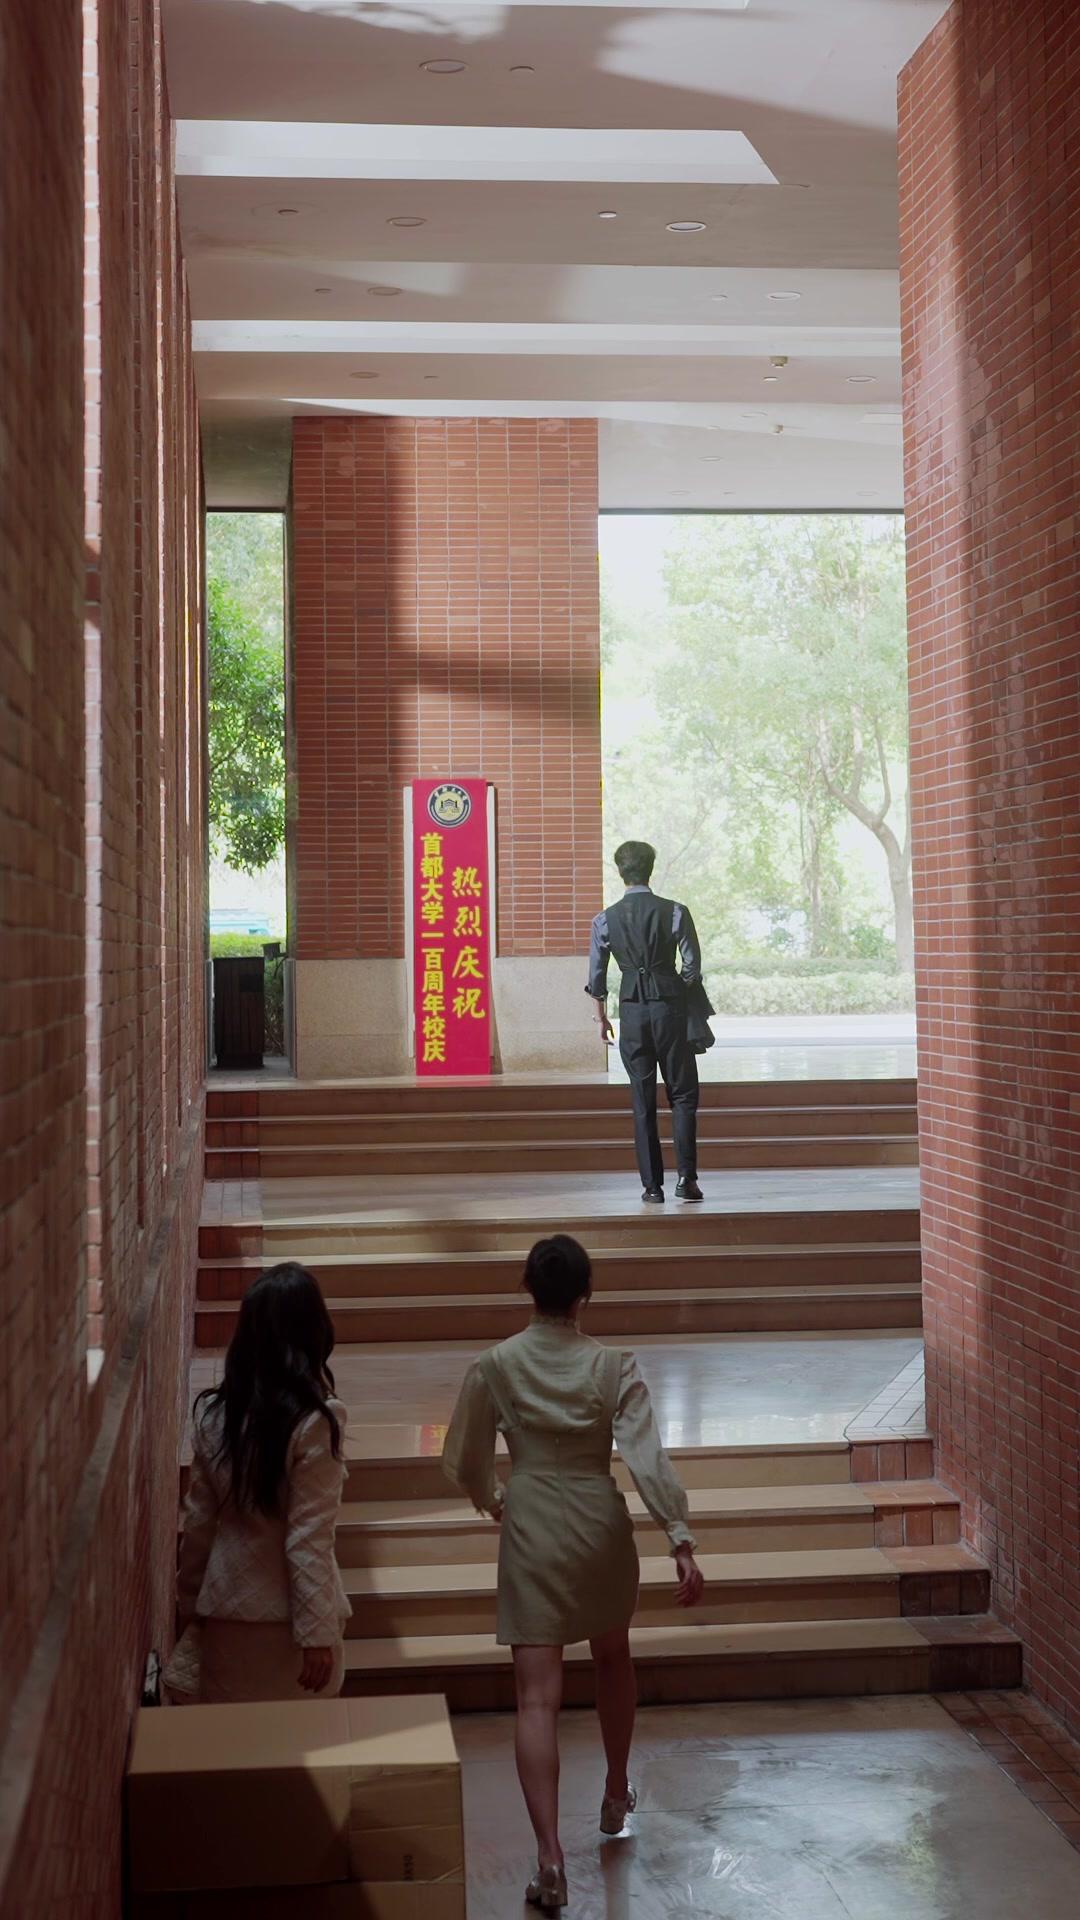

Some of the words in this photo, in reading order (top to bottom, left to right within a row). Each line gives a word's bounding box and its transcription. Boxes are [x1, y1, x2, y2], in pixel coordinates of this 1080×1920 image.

[420, 831, 445, 1063] 首都大学一百周年校庆
[451, 866, 486, 1019] 热烈庆祝
